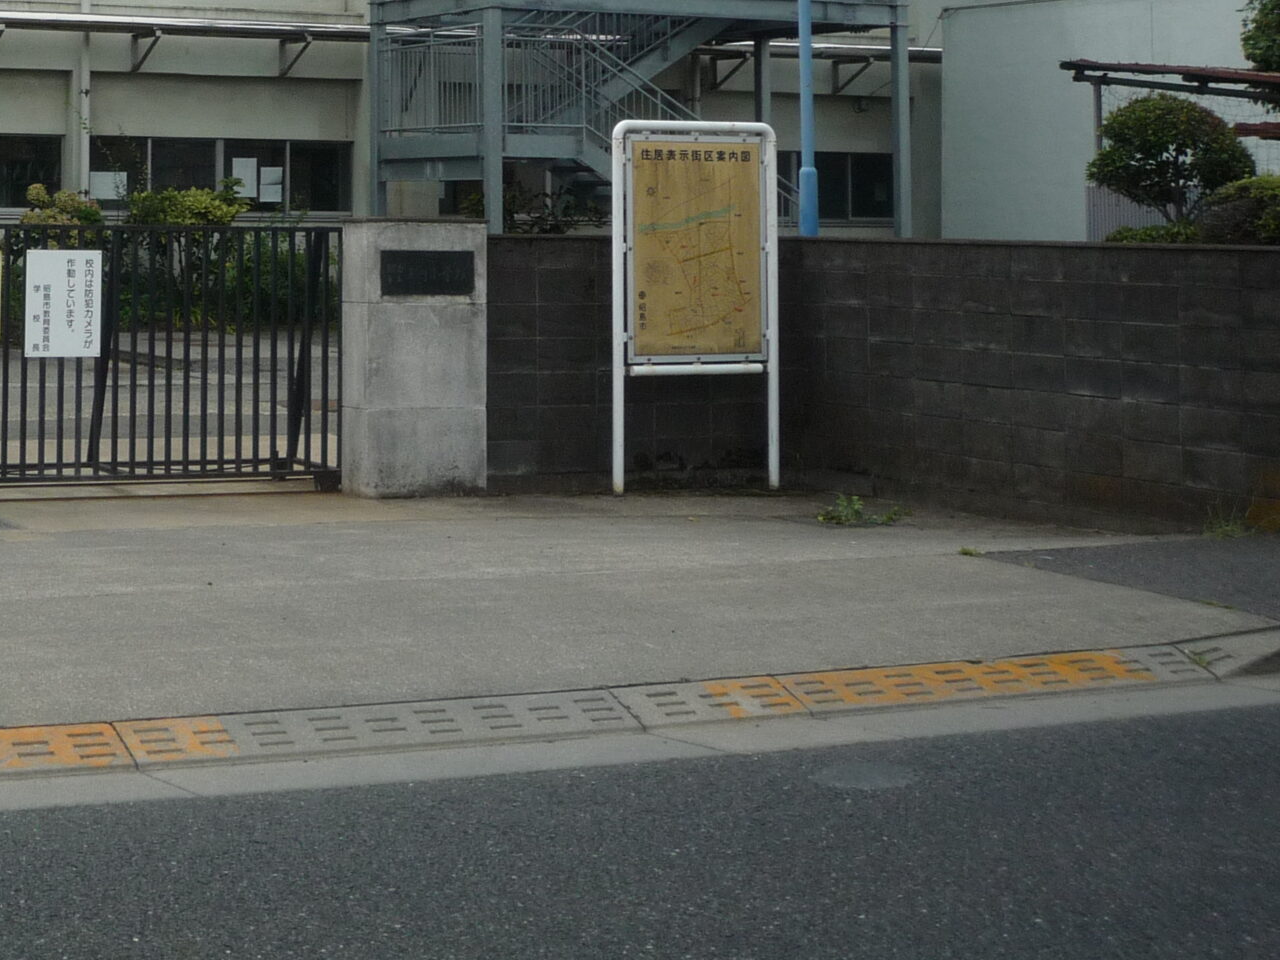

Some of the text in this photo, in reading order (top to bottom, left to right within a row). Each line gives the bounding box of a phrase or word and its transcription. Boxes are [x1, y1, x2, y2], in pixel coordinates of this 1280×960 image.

[640, 148, 751, 163] 住居表示街区案内図
[42, 284, 51, 352] 昭島市教育委員会
[66, 259, 76, 333] 作動しています。
[83, 259, 95, 350] 校内は防犯カメラが
